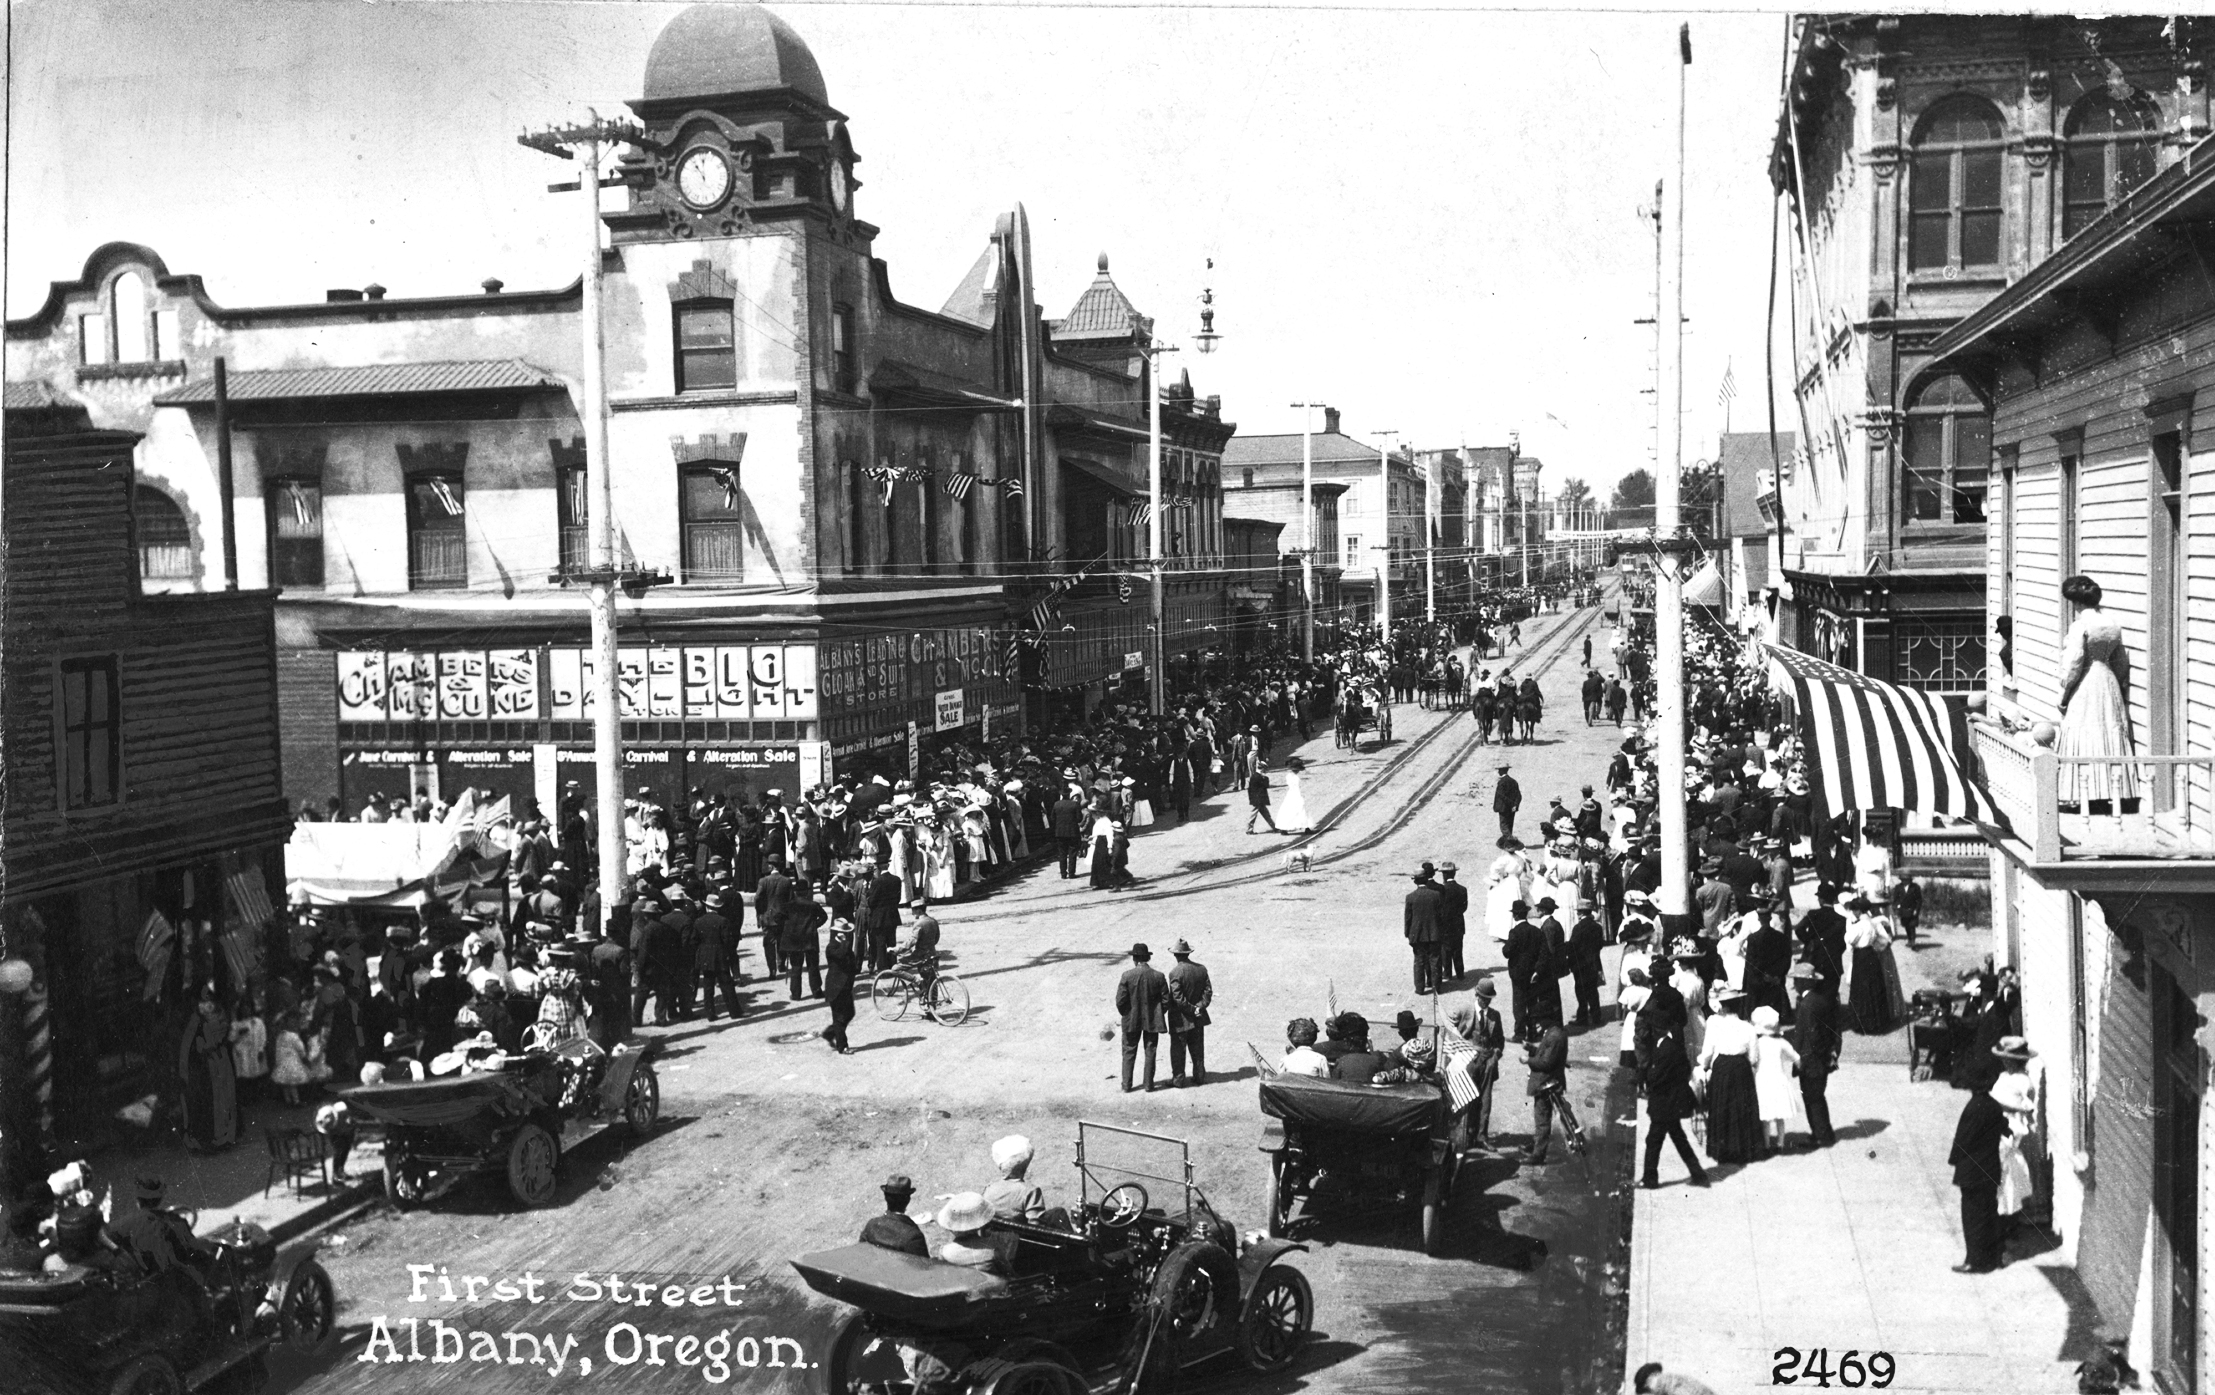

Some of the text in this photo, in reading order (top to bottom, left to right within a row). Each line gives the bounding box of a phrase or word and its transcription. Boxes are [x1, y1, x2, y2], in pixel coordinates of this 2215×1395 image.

[867, 639, 905, 663] LEADING
[911, 629, 1000, 664] CHAMBERS
[683, 651, 784, 688] BIG
[879, 663, 905, 686] SUIT
[935, 662, 948, 687] &
[339, 657, 533, 707] CHAMBERS
[447, 677, 473, 692] &
[845, 687, 898, 706] STORE
[939, 711, 959, 726] SALE
[358, 750, 380, 763] June
[382, 750, 421, 763] Carnival
[448, 750, 501, 763] Alteration
[507, 749, 533, 763] Sale
[626, 750, 669, 763] Carnival
[686, 750, 697, 763] &
[703, 749, 759, 763] Alteration
[764, 748, 796, 763] Sale
